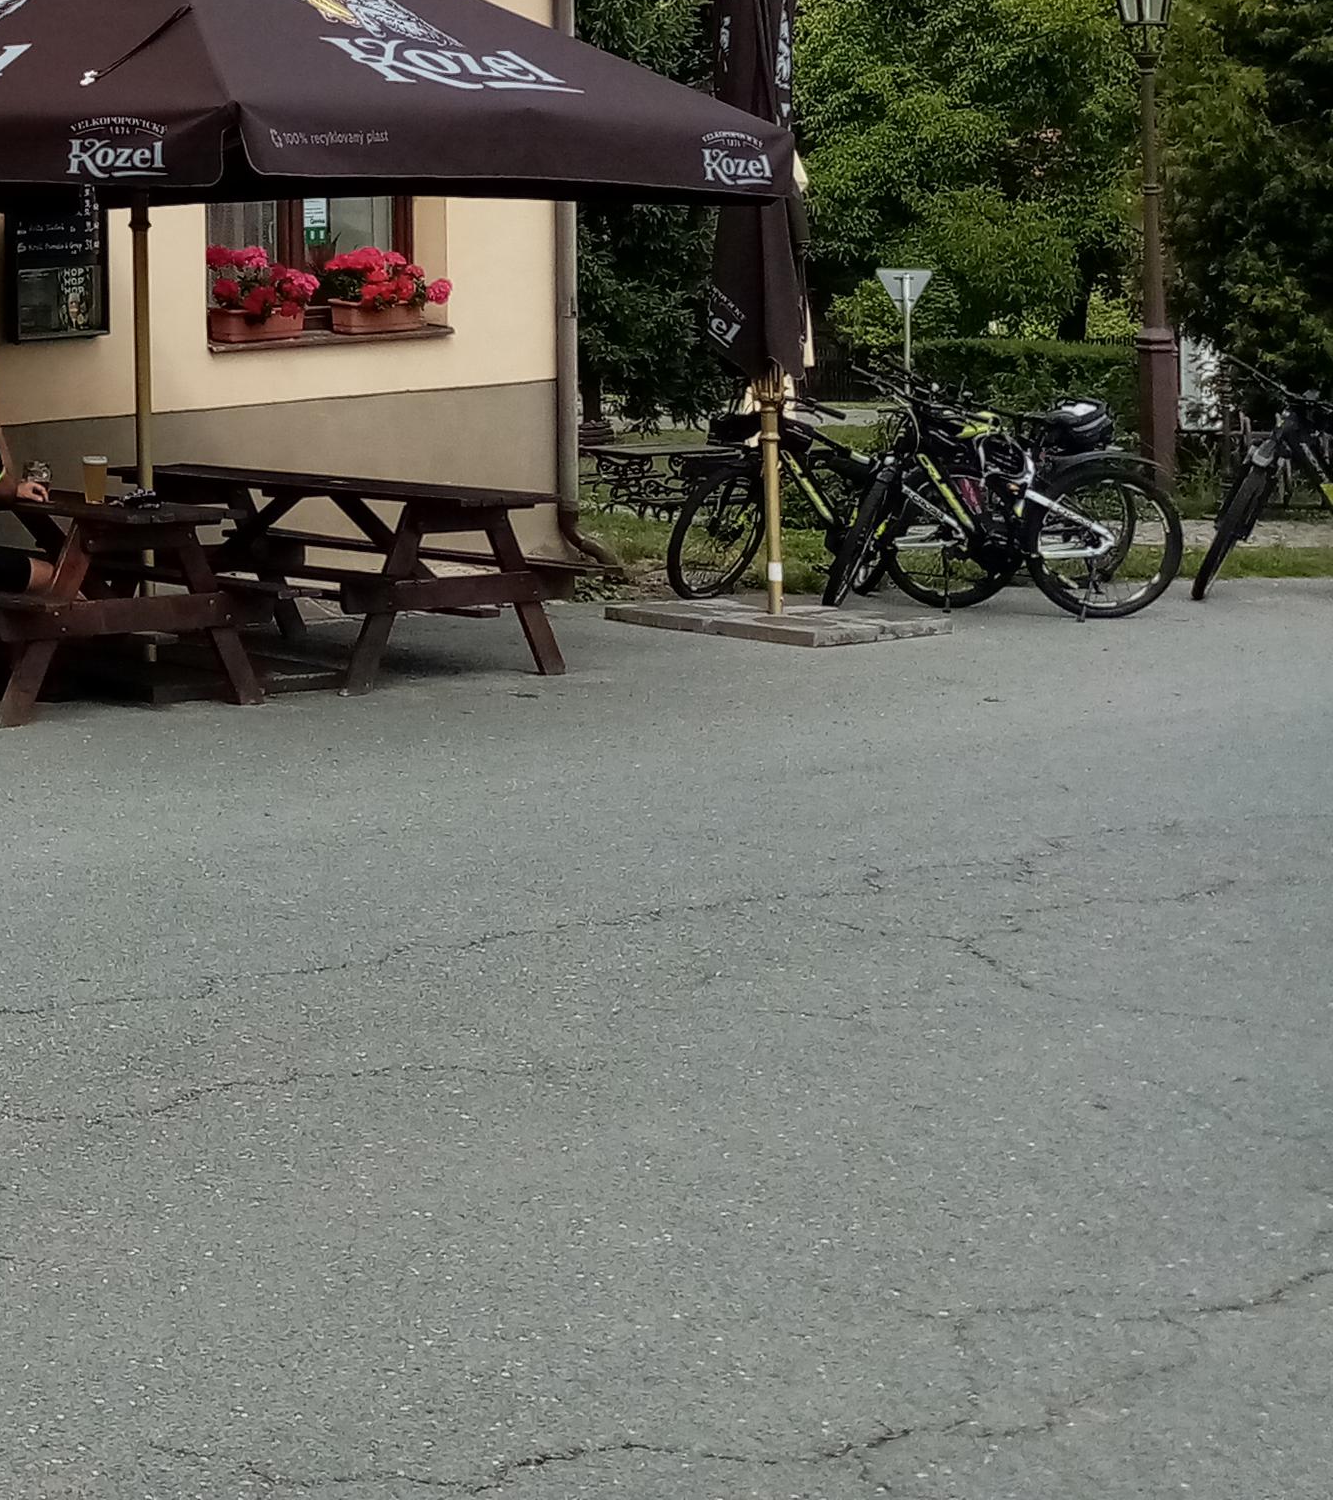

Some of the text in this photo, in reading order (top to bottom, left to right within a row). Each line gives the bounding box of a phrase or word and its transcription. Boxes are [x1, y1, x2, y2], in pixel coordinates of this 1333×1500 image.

[319, 36, 566, 89] Kozel
[283, 130, 389, 147] 100% recyklovaný plast
[66, 138, 167, 179] Kozel
[701, 148, 773, 186] Kozel
